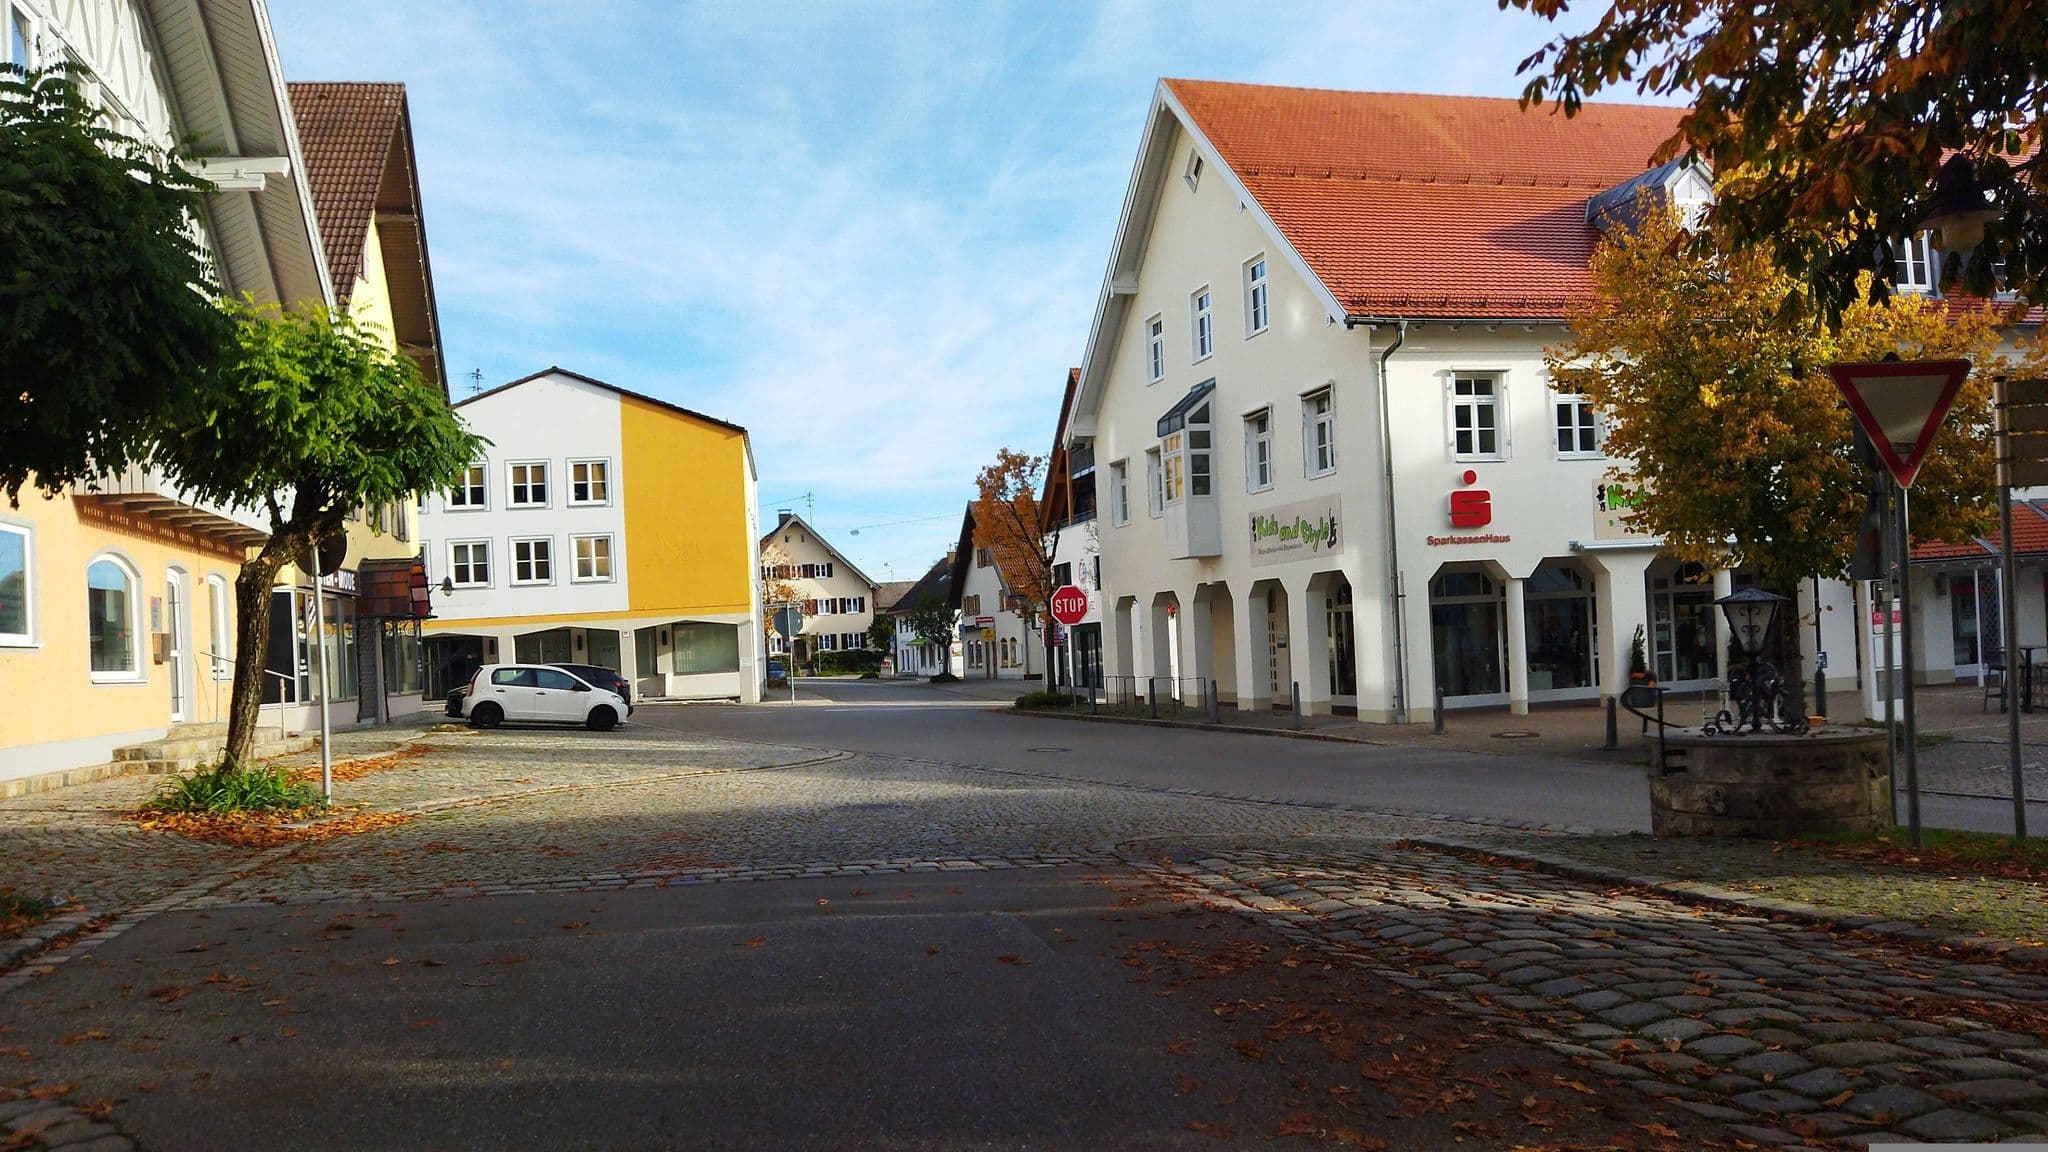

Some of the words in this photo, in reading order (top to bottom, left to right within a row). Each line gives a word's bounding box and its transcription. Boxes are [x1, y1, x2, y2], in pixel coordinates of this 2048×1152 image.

[1257, 513, 1279, 540] Kids
[1279, 515, 1300, 541] and
[1300, 516, 1329, 552] Style
[1427, 533, 1511, 547] SparkassenHaus
[338, 570, 355, 590] MODE
[1055, 597, 1084, 613] STOP
